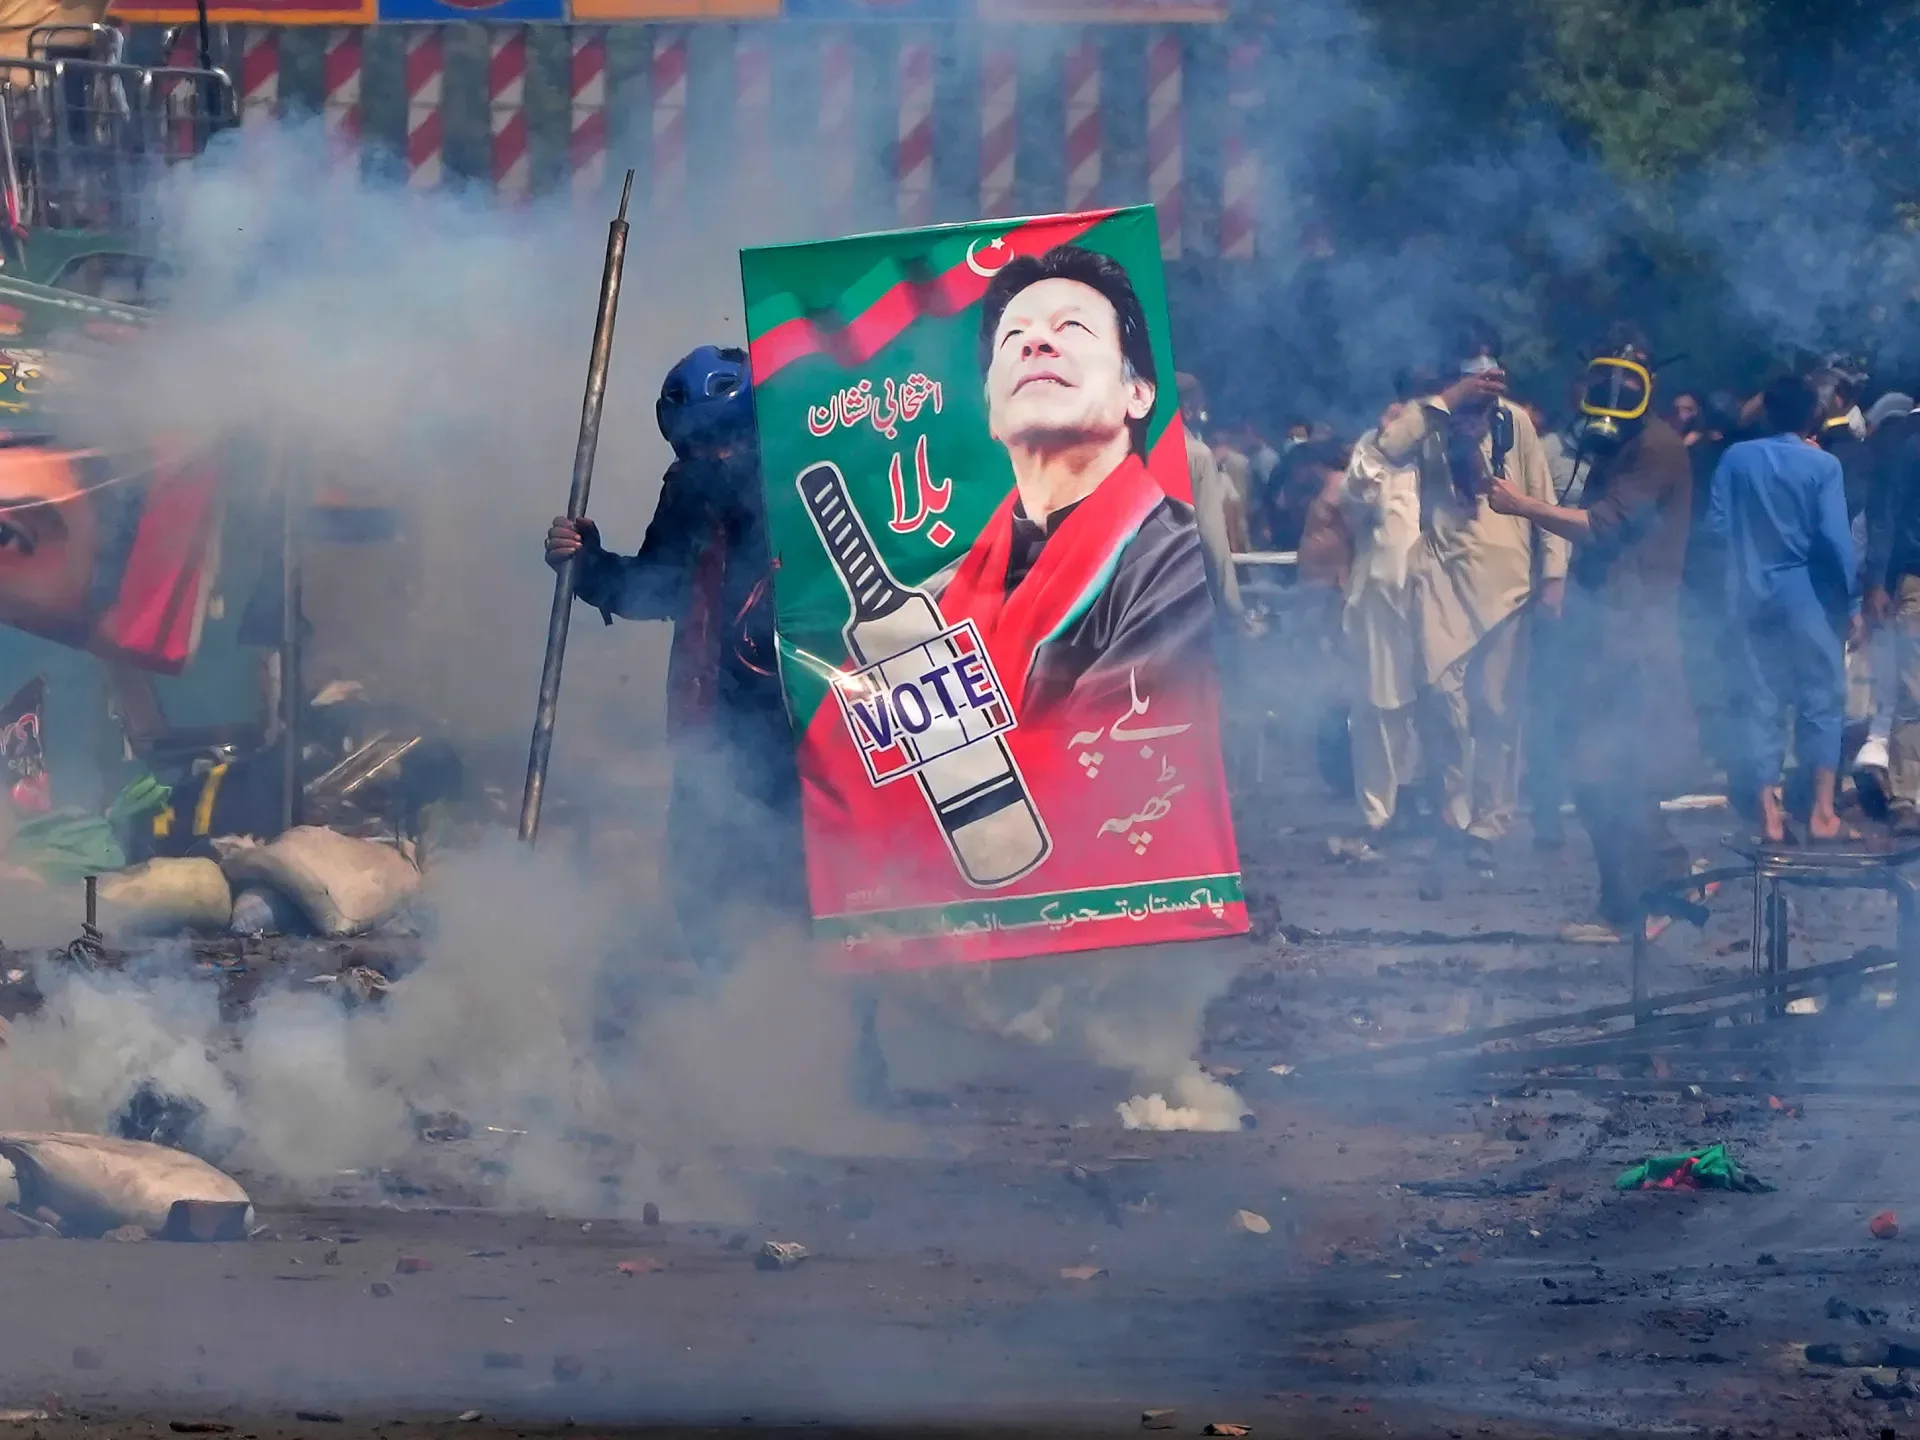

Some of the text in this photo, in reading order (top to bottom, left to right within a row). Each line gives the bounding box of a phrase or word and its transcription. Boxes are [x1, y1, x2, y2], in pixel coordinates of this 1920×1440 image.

[807, 373, 942, 440] انتخابی نشان
[888, 433, 955, 548] بلا
[852, 654, 996, 749] VOTE
[999, 899, 1128, 932] تحریک
[1128, 887, 1225, 921] پاکستان
